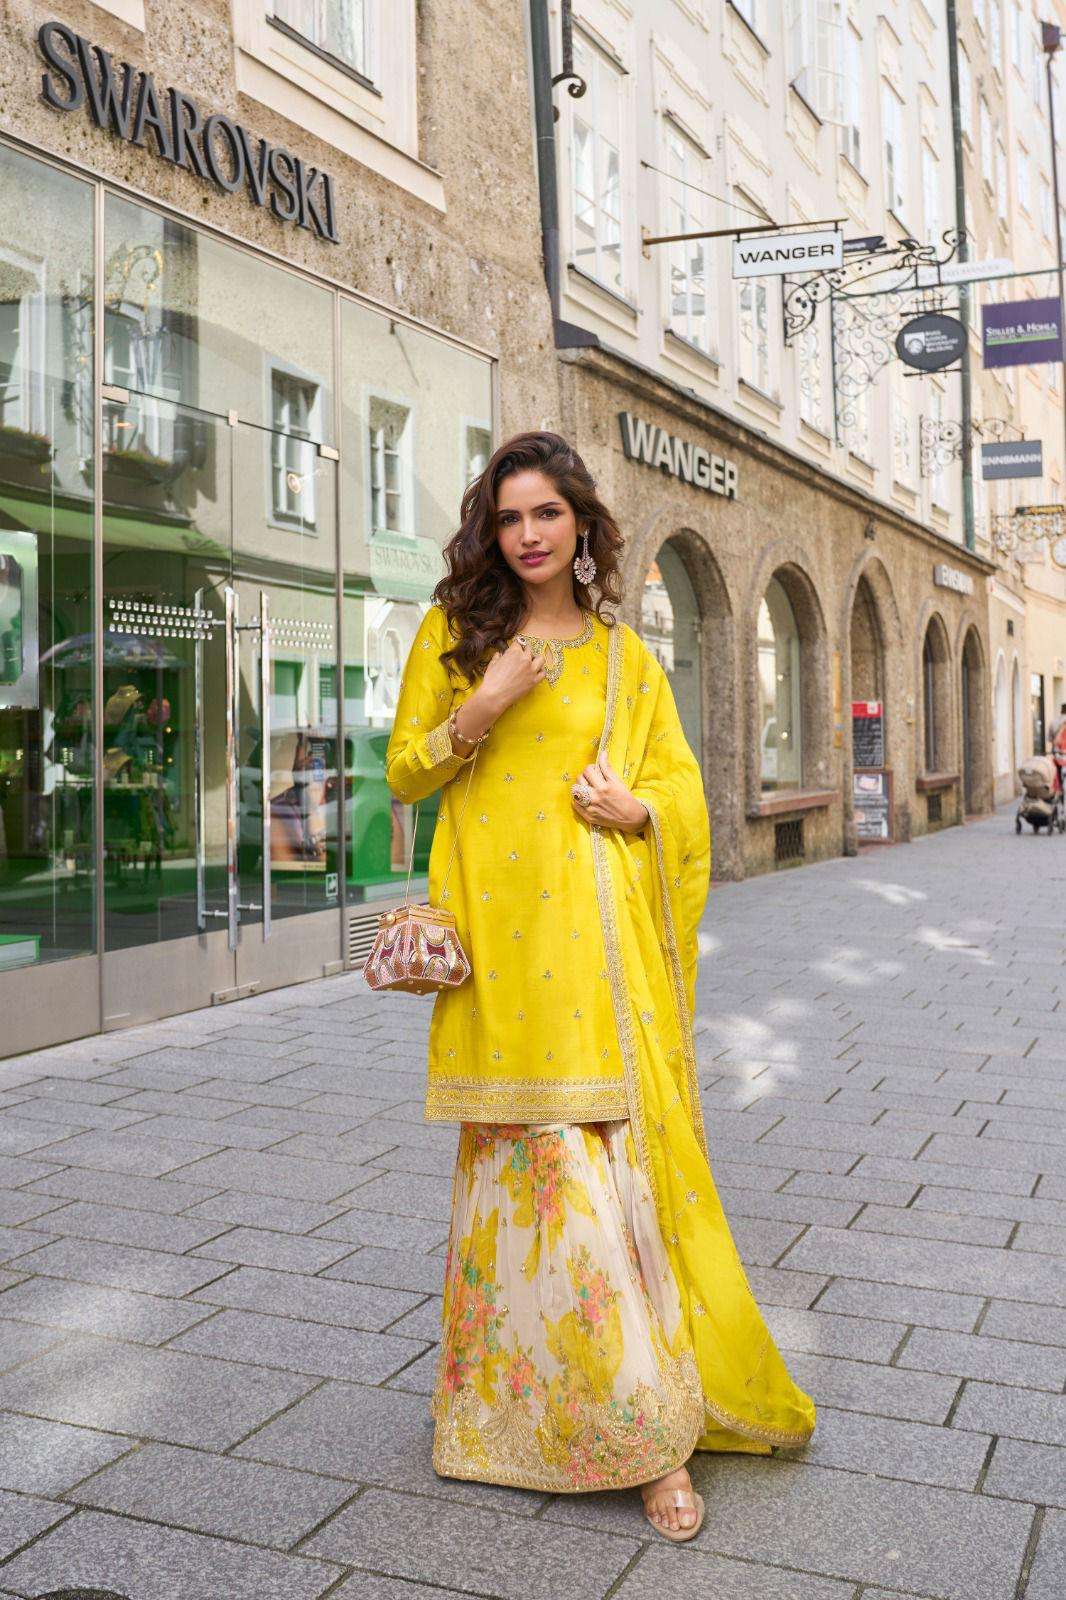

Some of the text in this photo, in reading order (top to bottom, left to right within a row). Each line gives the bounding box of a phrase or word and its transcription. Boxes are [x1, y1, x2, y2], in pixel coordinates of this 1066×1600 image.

[37, 21, 340, 244] SWAROVSKI
[740, 244, 834, 264] WANGER
[618, 411, 738, 499] WANGER
